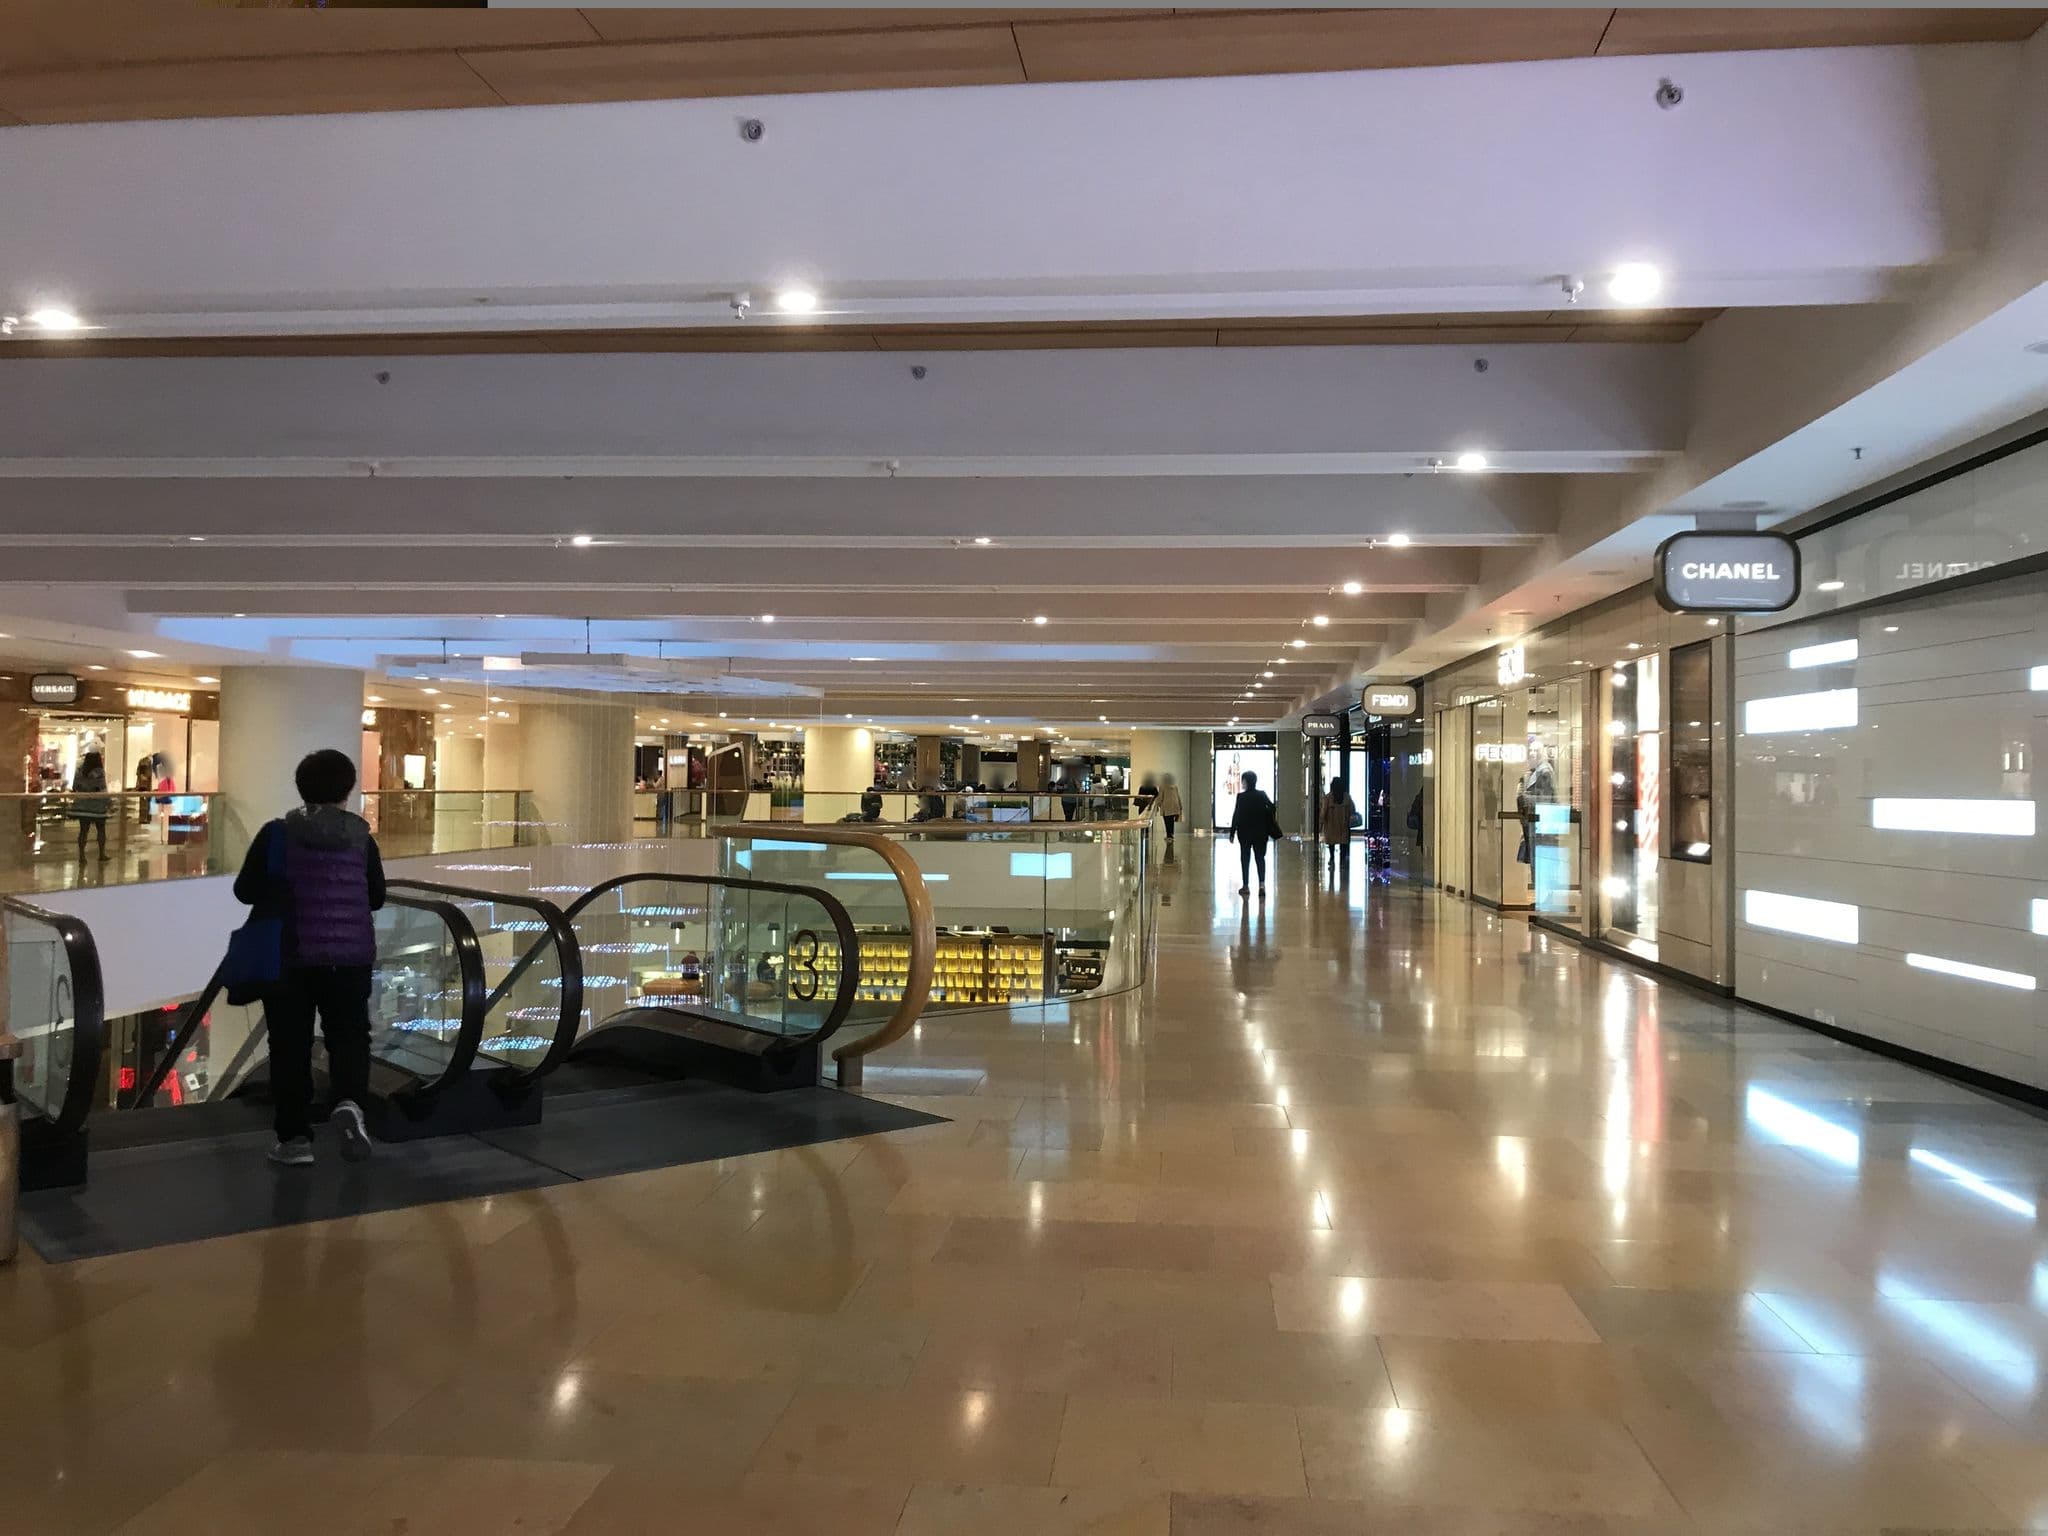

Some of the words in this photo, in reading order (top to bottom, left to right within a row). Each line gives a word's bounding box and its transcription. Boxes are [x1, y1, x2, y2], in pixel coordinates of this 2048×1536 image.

[1681, 562, 1782, 580] CHANEL
[34, 685, 76, 693] VERSACE
[1372, 694, 1409, 707] FENDI
[1307, 721, 1335, 730] PRADA
[792, 929, 819, 1002] 3
